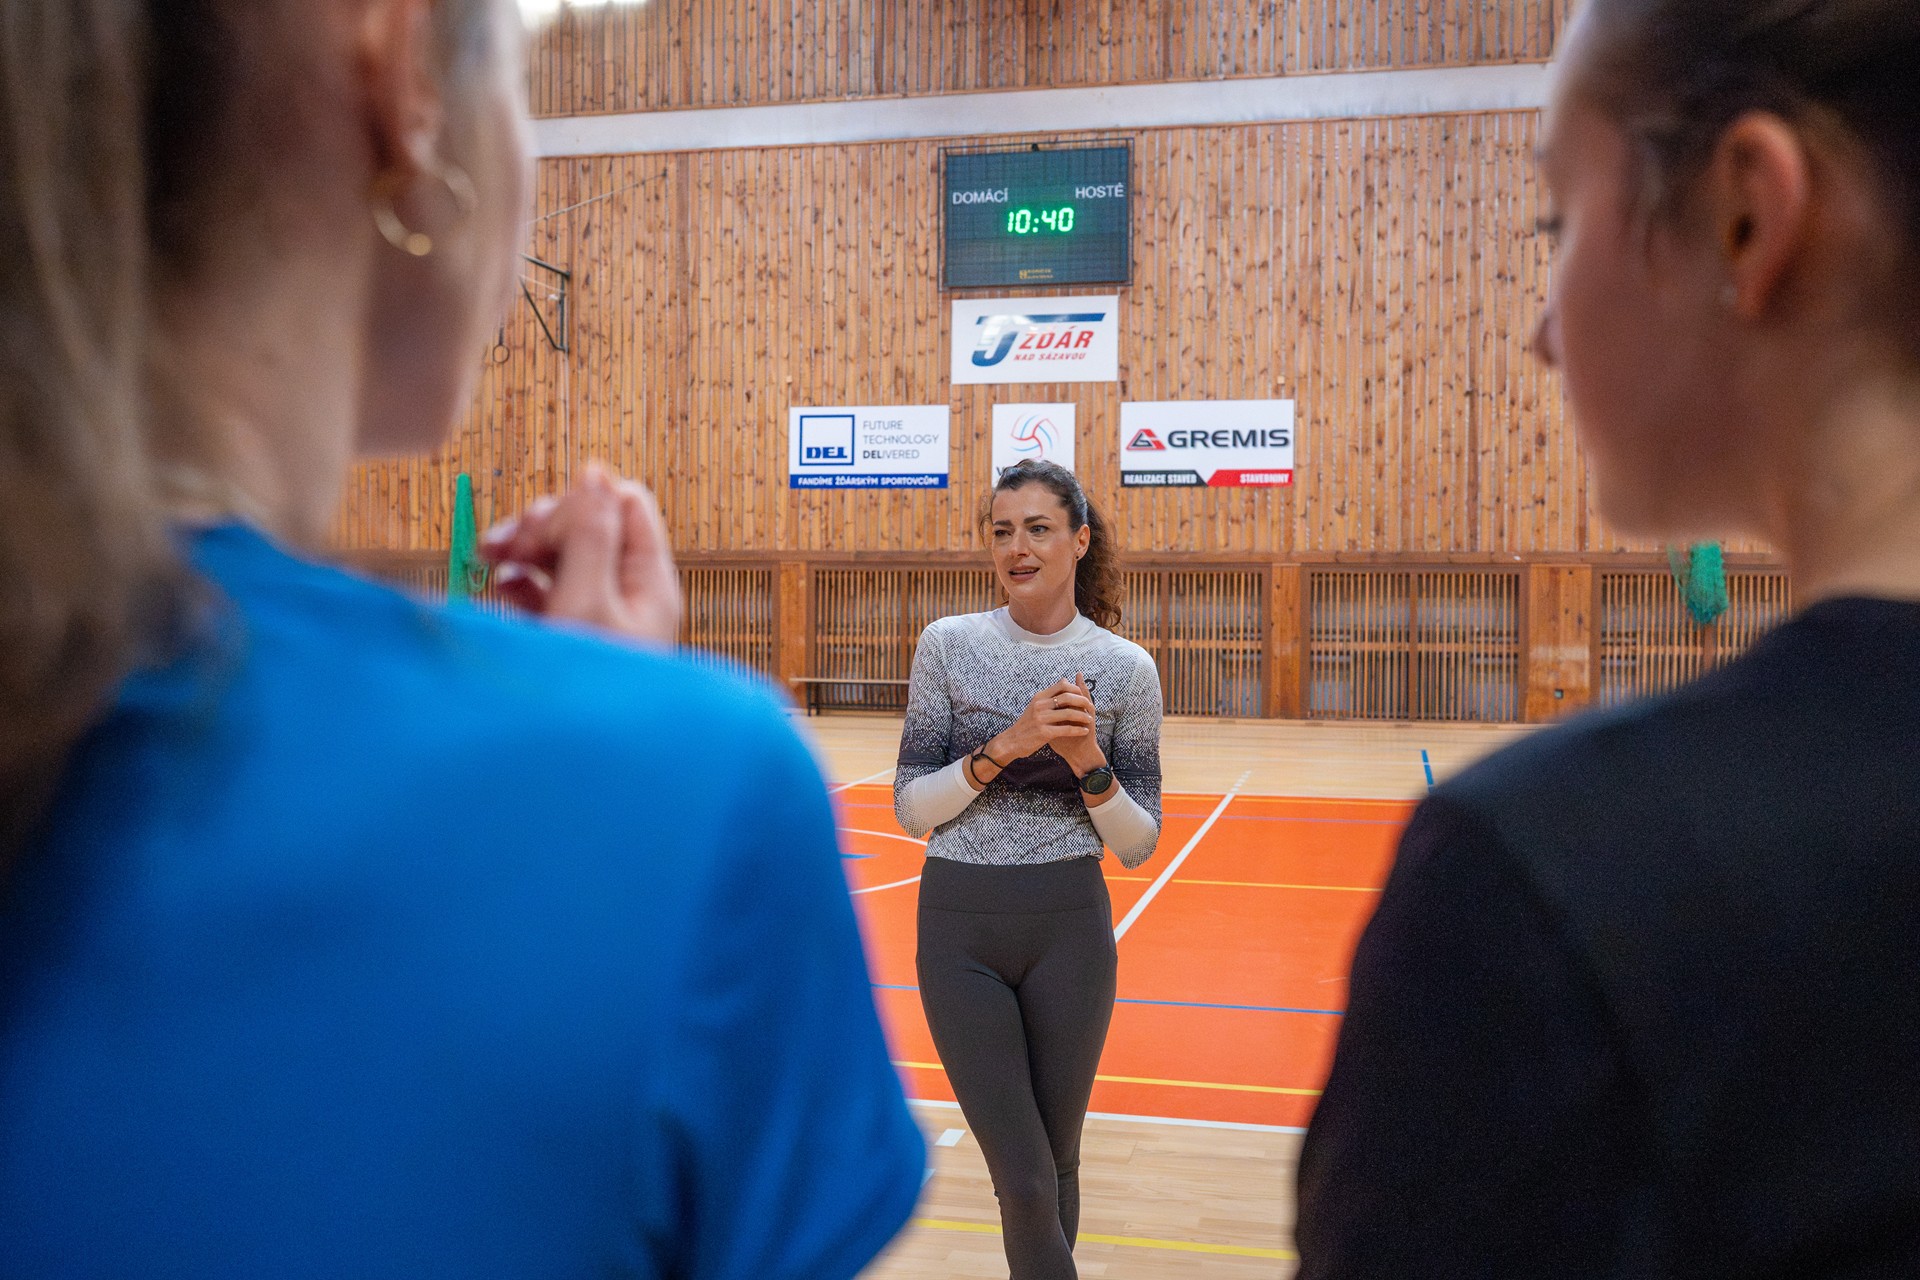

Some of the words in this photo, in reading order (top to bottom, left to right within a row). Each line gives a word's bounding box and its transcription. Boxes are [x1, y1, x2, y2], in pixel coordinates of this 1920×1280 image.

[952, 187, 1009, 205] DOMÁCÍ
[1007, 207, 1075, 234] 10:40
[1013, 353, 1036, 361] NAD
[863, 420, 904, 430] FUTURE
[863, 434, 940, 445] TECHNOLOGY
[1167, 429, 1290, 448] GREMIS
[806, 446, 848, 459] DEL
[863, 449, 920, 459] DELIVERED
[1124, 474, 1167, 485] REALIZACE
[1167, 474, 1198, 485] STAVEB
